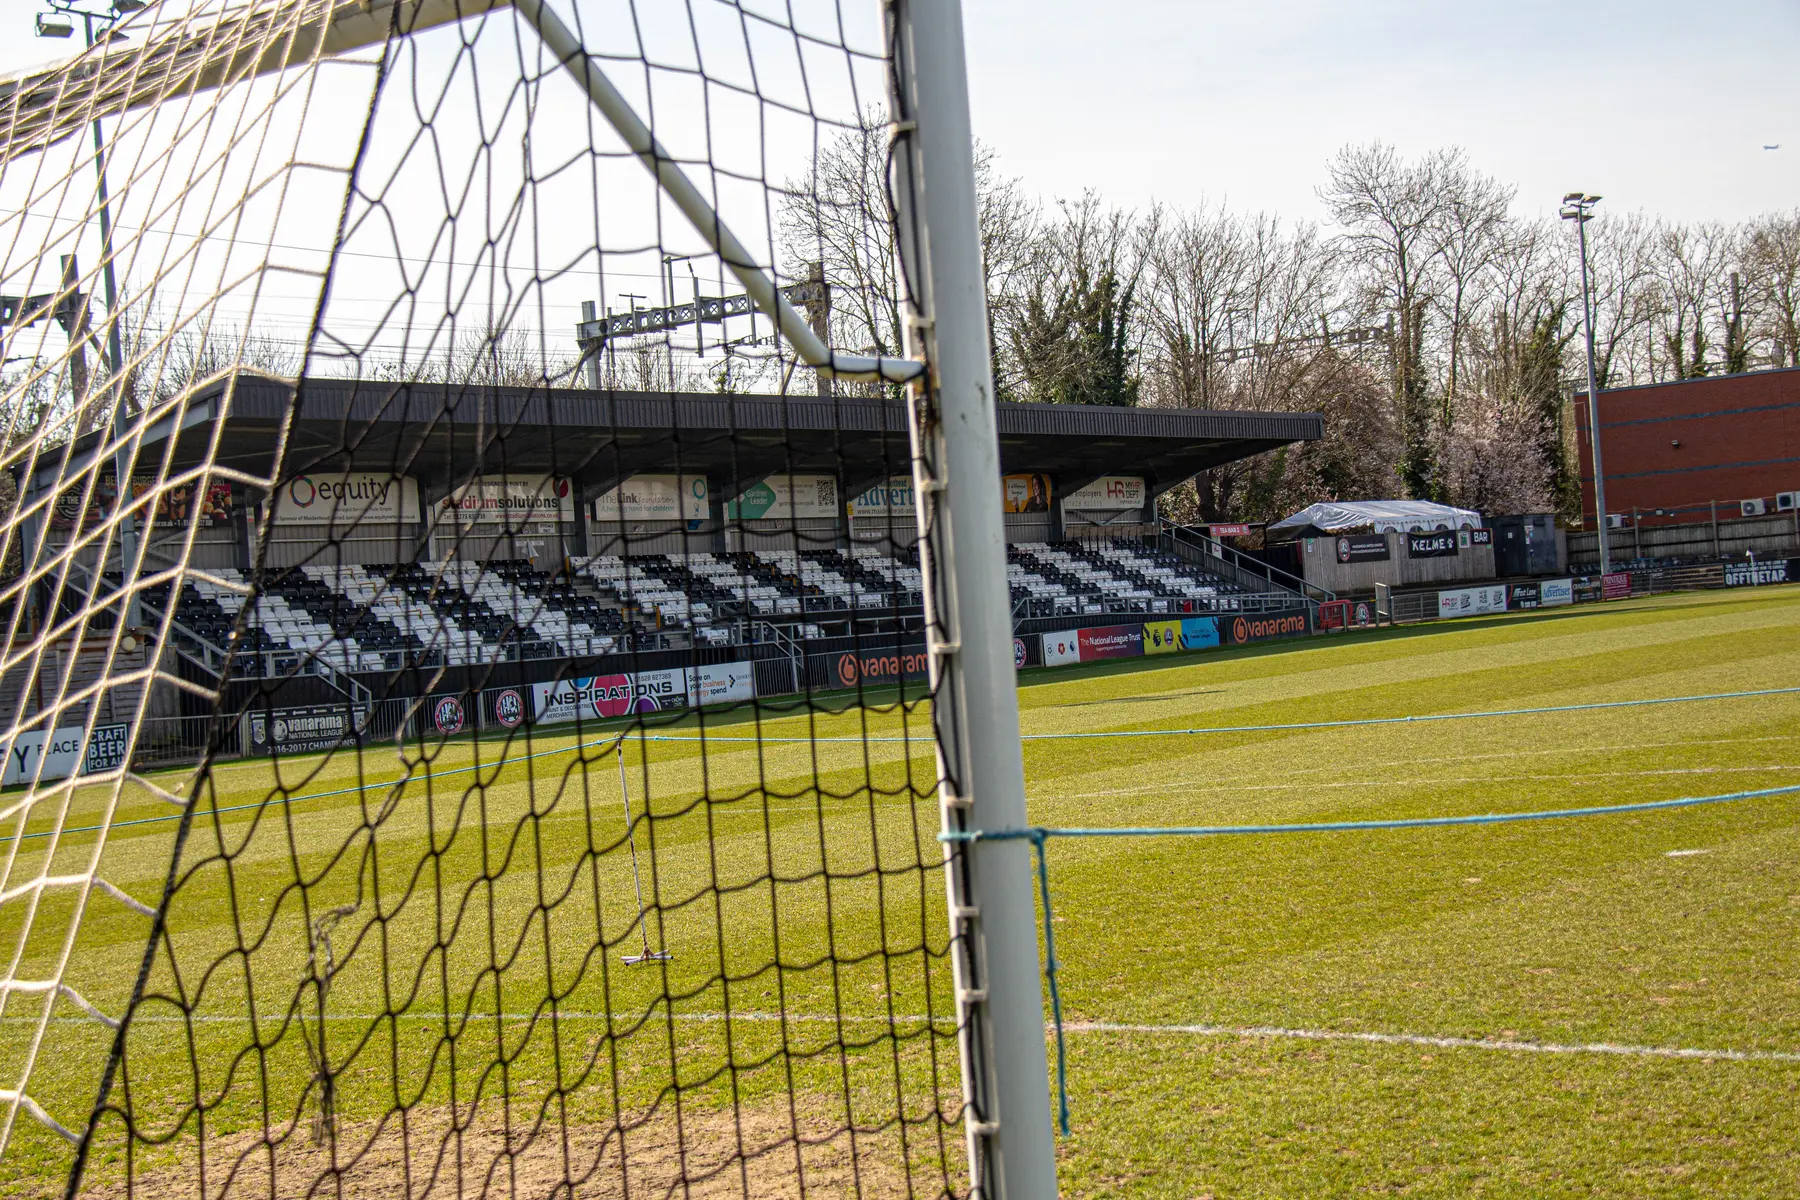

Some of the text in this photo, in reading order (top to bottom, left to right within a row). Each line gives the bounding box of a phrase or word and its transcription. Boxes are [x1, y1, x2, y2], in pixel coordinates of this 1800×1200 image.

[318, 476, 391, 506] equity
[746, 489, 768, 505] Gardner Leader
[857, 485, 915, 506] Advert
[1473, 531, 1488, 543] BAR
[1411, 538, 1446, 551] KELME
[1526, 588, 1536, 596] Lane
[1248, 615, 1305, 637] vanarama
[1080, 633, 1141, 646] The National League Trust
[860, 653, 929, 677] vanaram
[703, 680, 726, 688] business
[710, 686, 727, 696] spend
[287, 716, 343, 731] vanarama
[91, 728, 125, 742] CRAFT
[288, 729, 344, 740] NATIONAL LEAGUE
[37, 740, 79, 756] PACE
[89, 740, 125, 758] BEER
[91, 758, 108, 768] FOR
